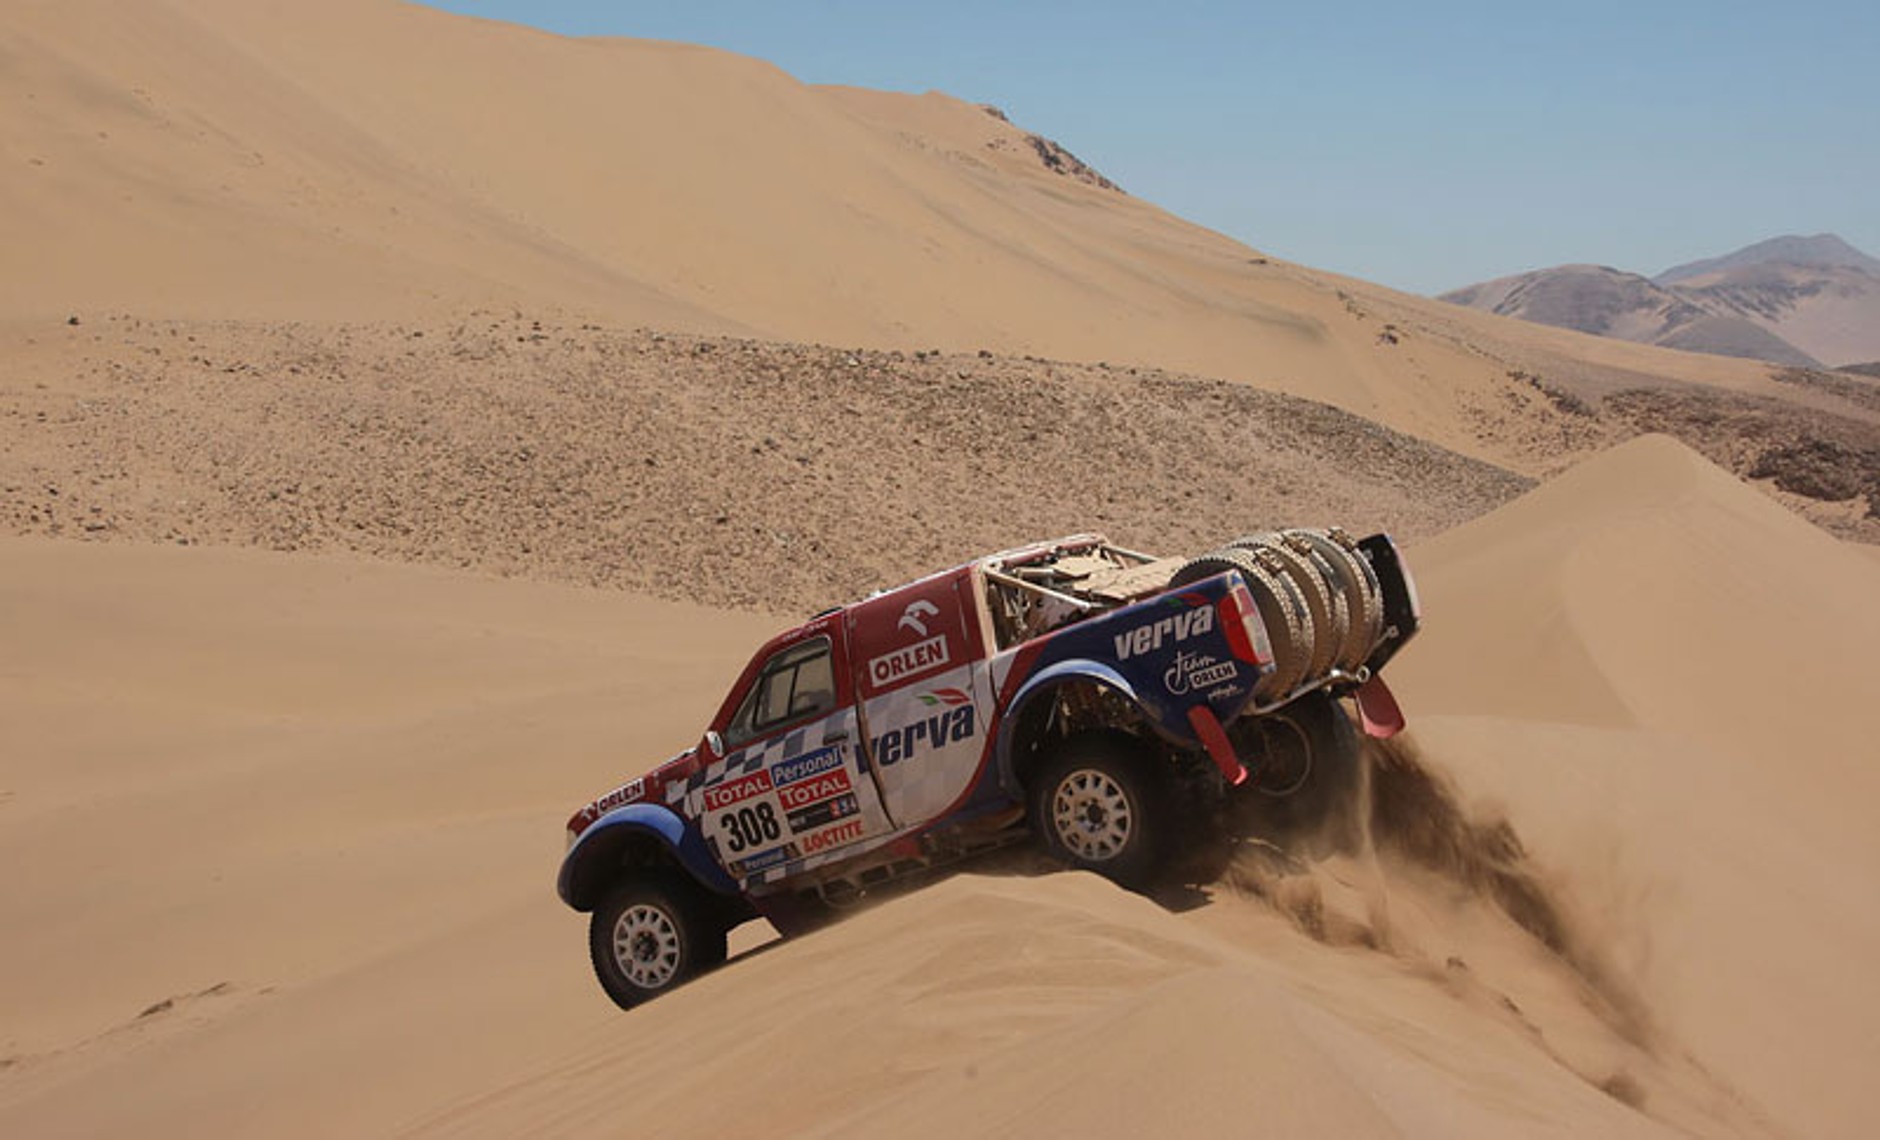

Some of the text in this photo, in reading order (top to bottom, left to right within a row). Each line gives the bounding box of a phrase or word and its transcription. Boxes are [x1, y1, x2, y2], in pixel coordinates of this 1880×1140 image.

[1114, 604, 1214, 661] verva
[874, 640, 943, 680] ORLEN
[1193, 664, 1233, 686] ORLEN
[854, 704, 974, 774] verva
[774, 748, 839, 784] Personal
[599, 781, 642, 811] ORLEN
[710, 779, 770, 807] TOTAL
[782, 778, 848, 806] TOTAL
[721, 802, 780, 851] 308
[803, 820, 864, 853] LOCTITE
